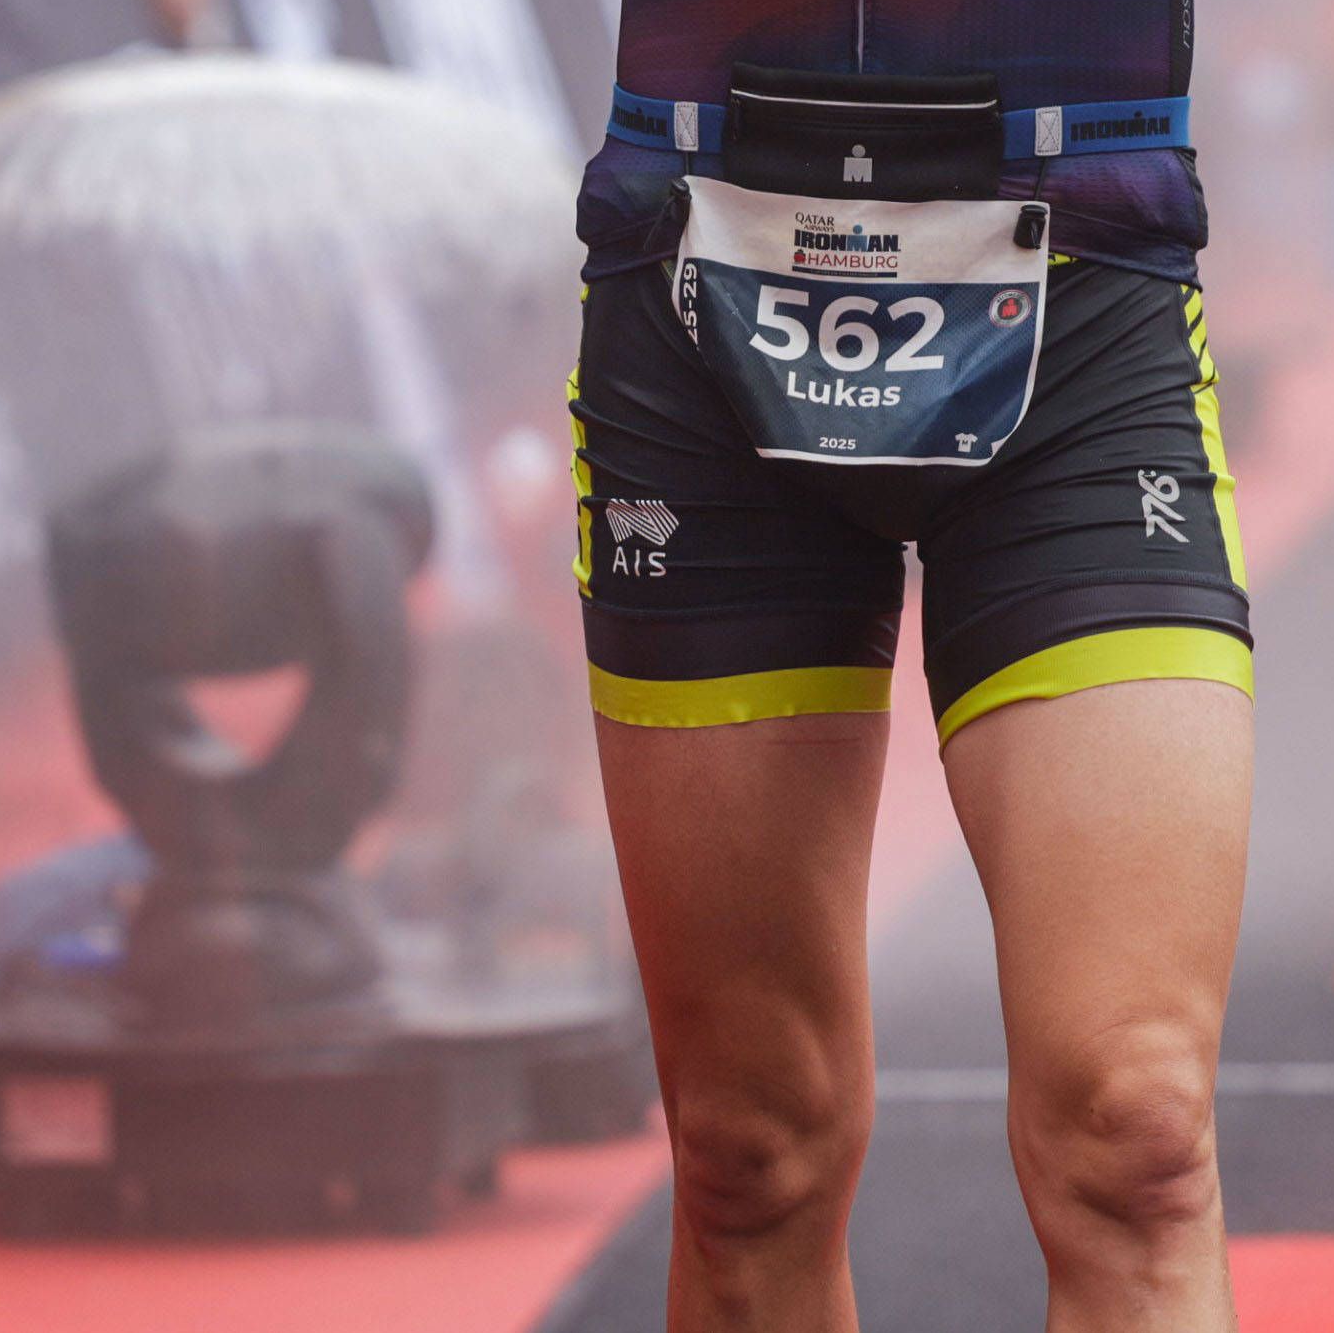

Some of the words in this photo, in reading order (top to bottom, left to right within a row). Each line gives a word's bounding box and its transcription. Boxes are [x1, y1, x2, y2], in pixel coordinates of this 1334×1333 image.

[1071, 111, 1170, 141] IRONMAN
[795, 212, 835, 227] QATAR
[794, 224, 899, 252] IRONMAN
[808, 253, 898, 269] HAMBURG
[749, 284, 945, 372] 562
[786, 371, 902, 408] Lukas
[819, 436, 857, 450] 2025
[612, 546, 667, 578] AIS
